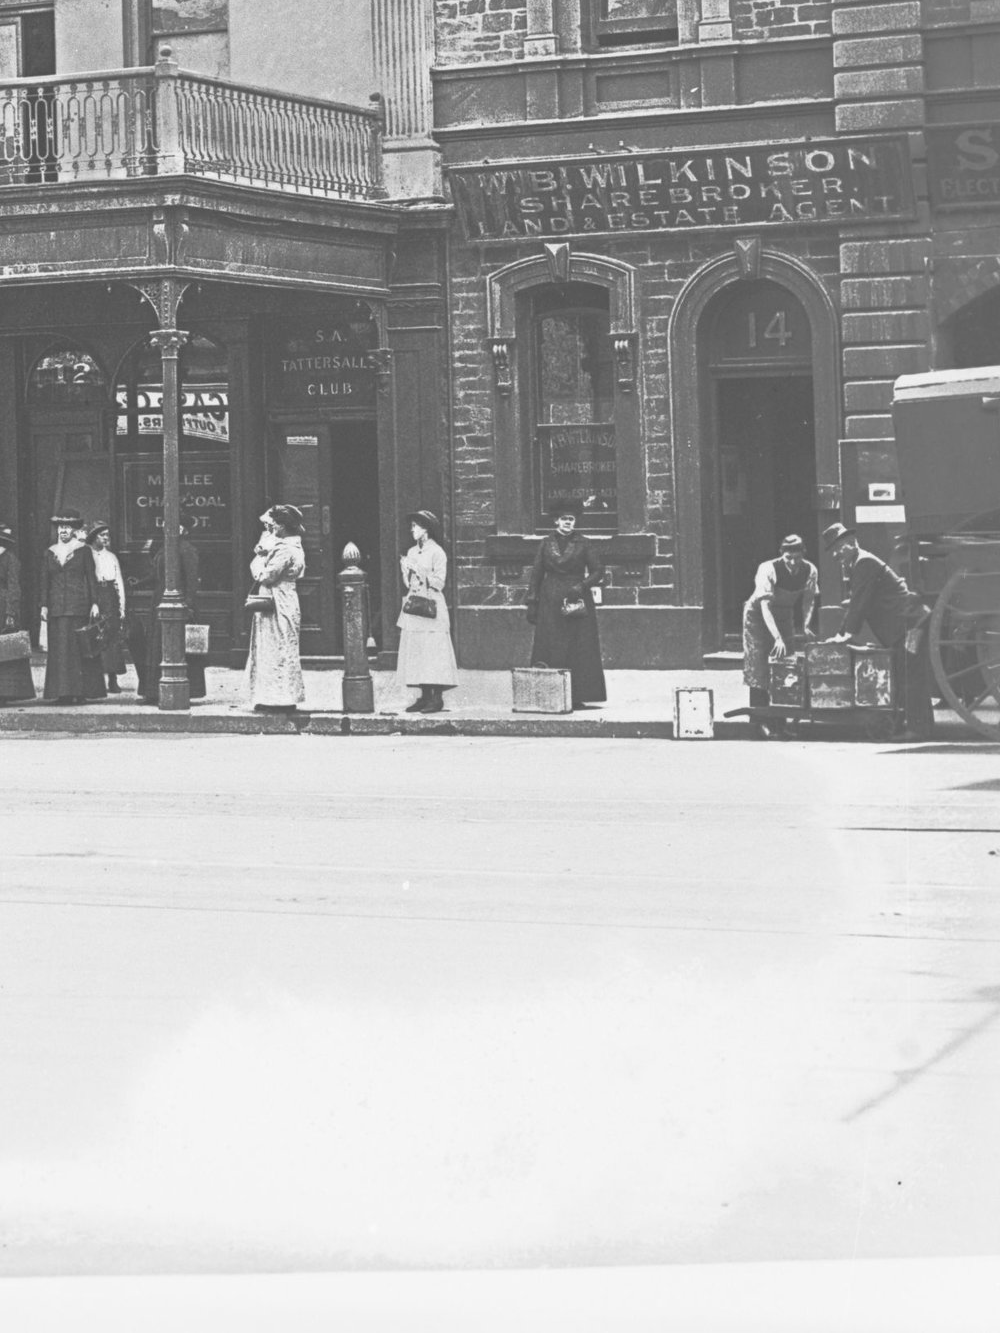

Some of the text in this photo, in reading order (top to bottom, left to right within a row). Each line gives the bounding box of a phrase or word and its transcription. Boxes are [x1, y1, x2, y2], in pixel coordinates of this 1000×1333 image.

[579, 147, 878, 189] WILKINSON
[478, 196, 895, 237] LAND & ESTATE AGENT
[747, 311, 794, 347] 14
[55, 362, 92, 385] 12
[307, 382, 353, 396] CLUB
[148, 473, 214, 486] MLEE
[137, 494, 226, 509] CHCOAL
[155, 515, 212, 528] DOT.
